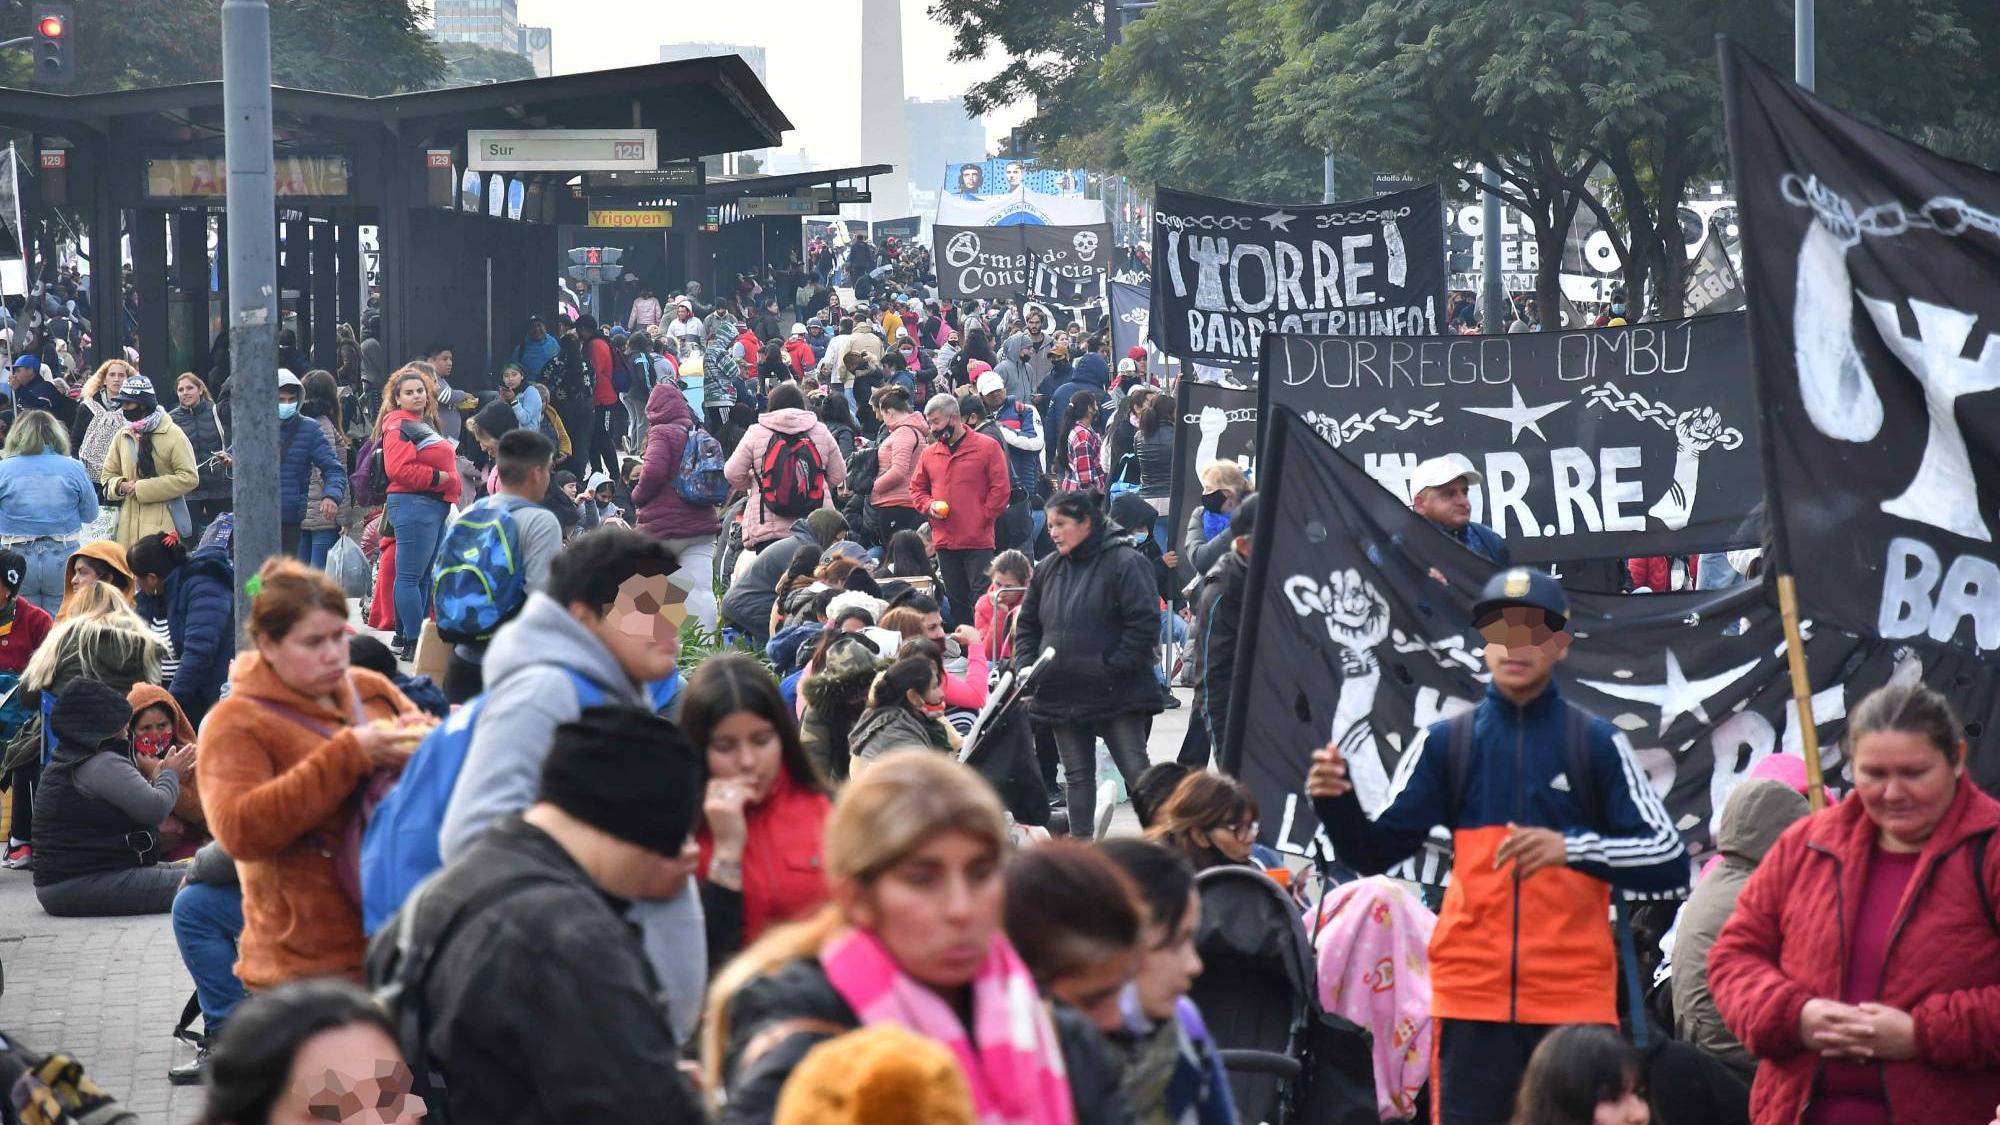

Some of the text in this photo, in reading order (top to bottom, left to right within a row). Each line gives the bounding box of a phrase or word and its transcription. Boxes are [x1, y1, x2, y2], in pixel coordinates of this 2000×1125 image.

[489, 144, 643, 159] Sur 129
[42, 155, 61, 166] 129
[431, 155, 449, 166] 129
[1376, 174, 1400, 182] Adolfo
[591, 212, 662, 227] Yrigoyen
[1282, 318, 1692, 388] DORREGO OMBÚ
